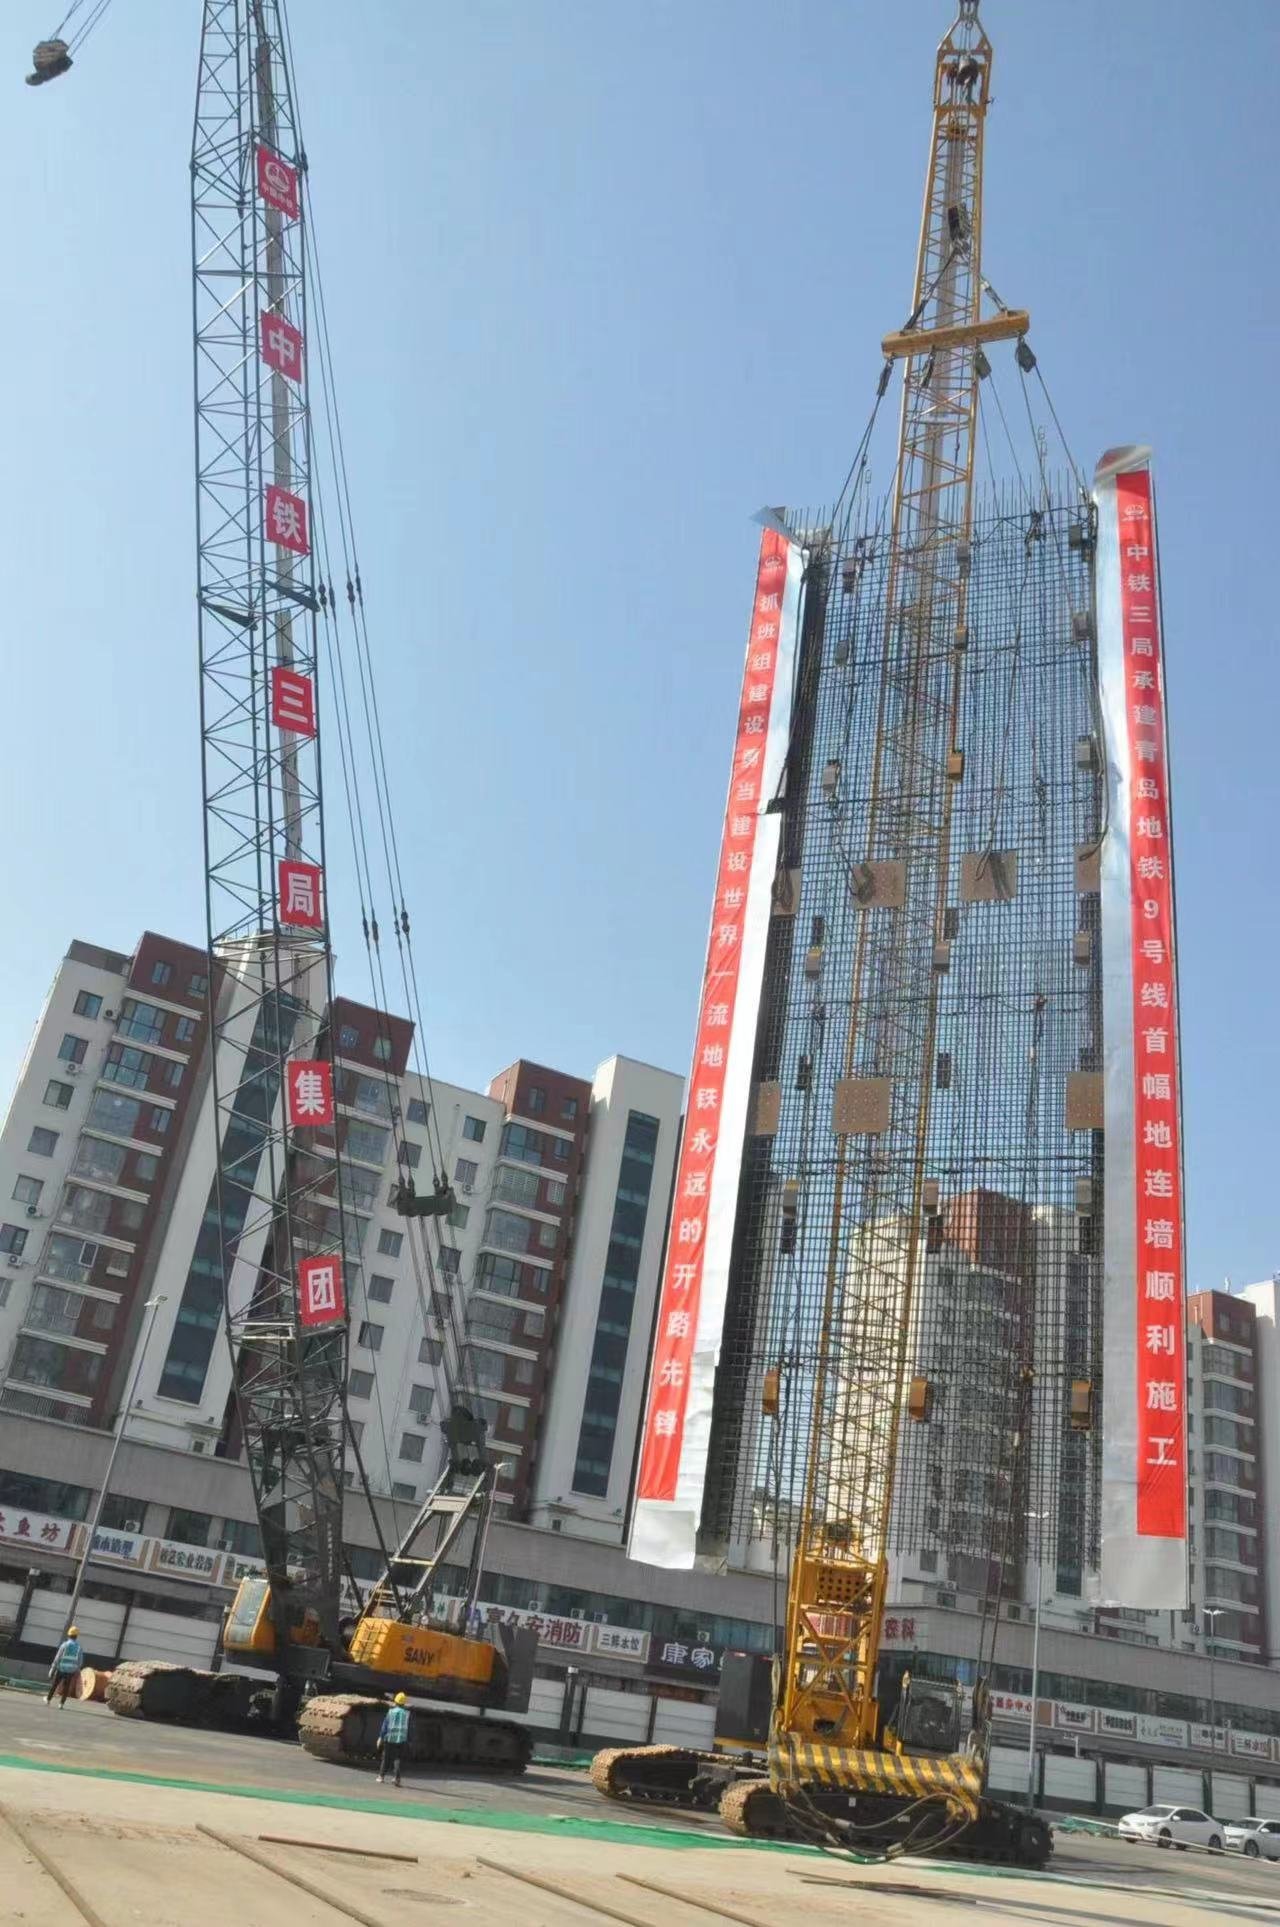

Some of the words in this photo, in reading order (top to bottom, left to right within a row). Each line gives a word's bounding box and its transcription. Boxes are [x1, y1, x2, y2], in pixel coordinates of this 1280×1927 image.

[1126, 544, 1177, 1466] 中铁三局承建青岛地铁9号线首幅地连墙顺利施工
[660, 1642, 722, 1672] 康家
